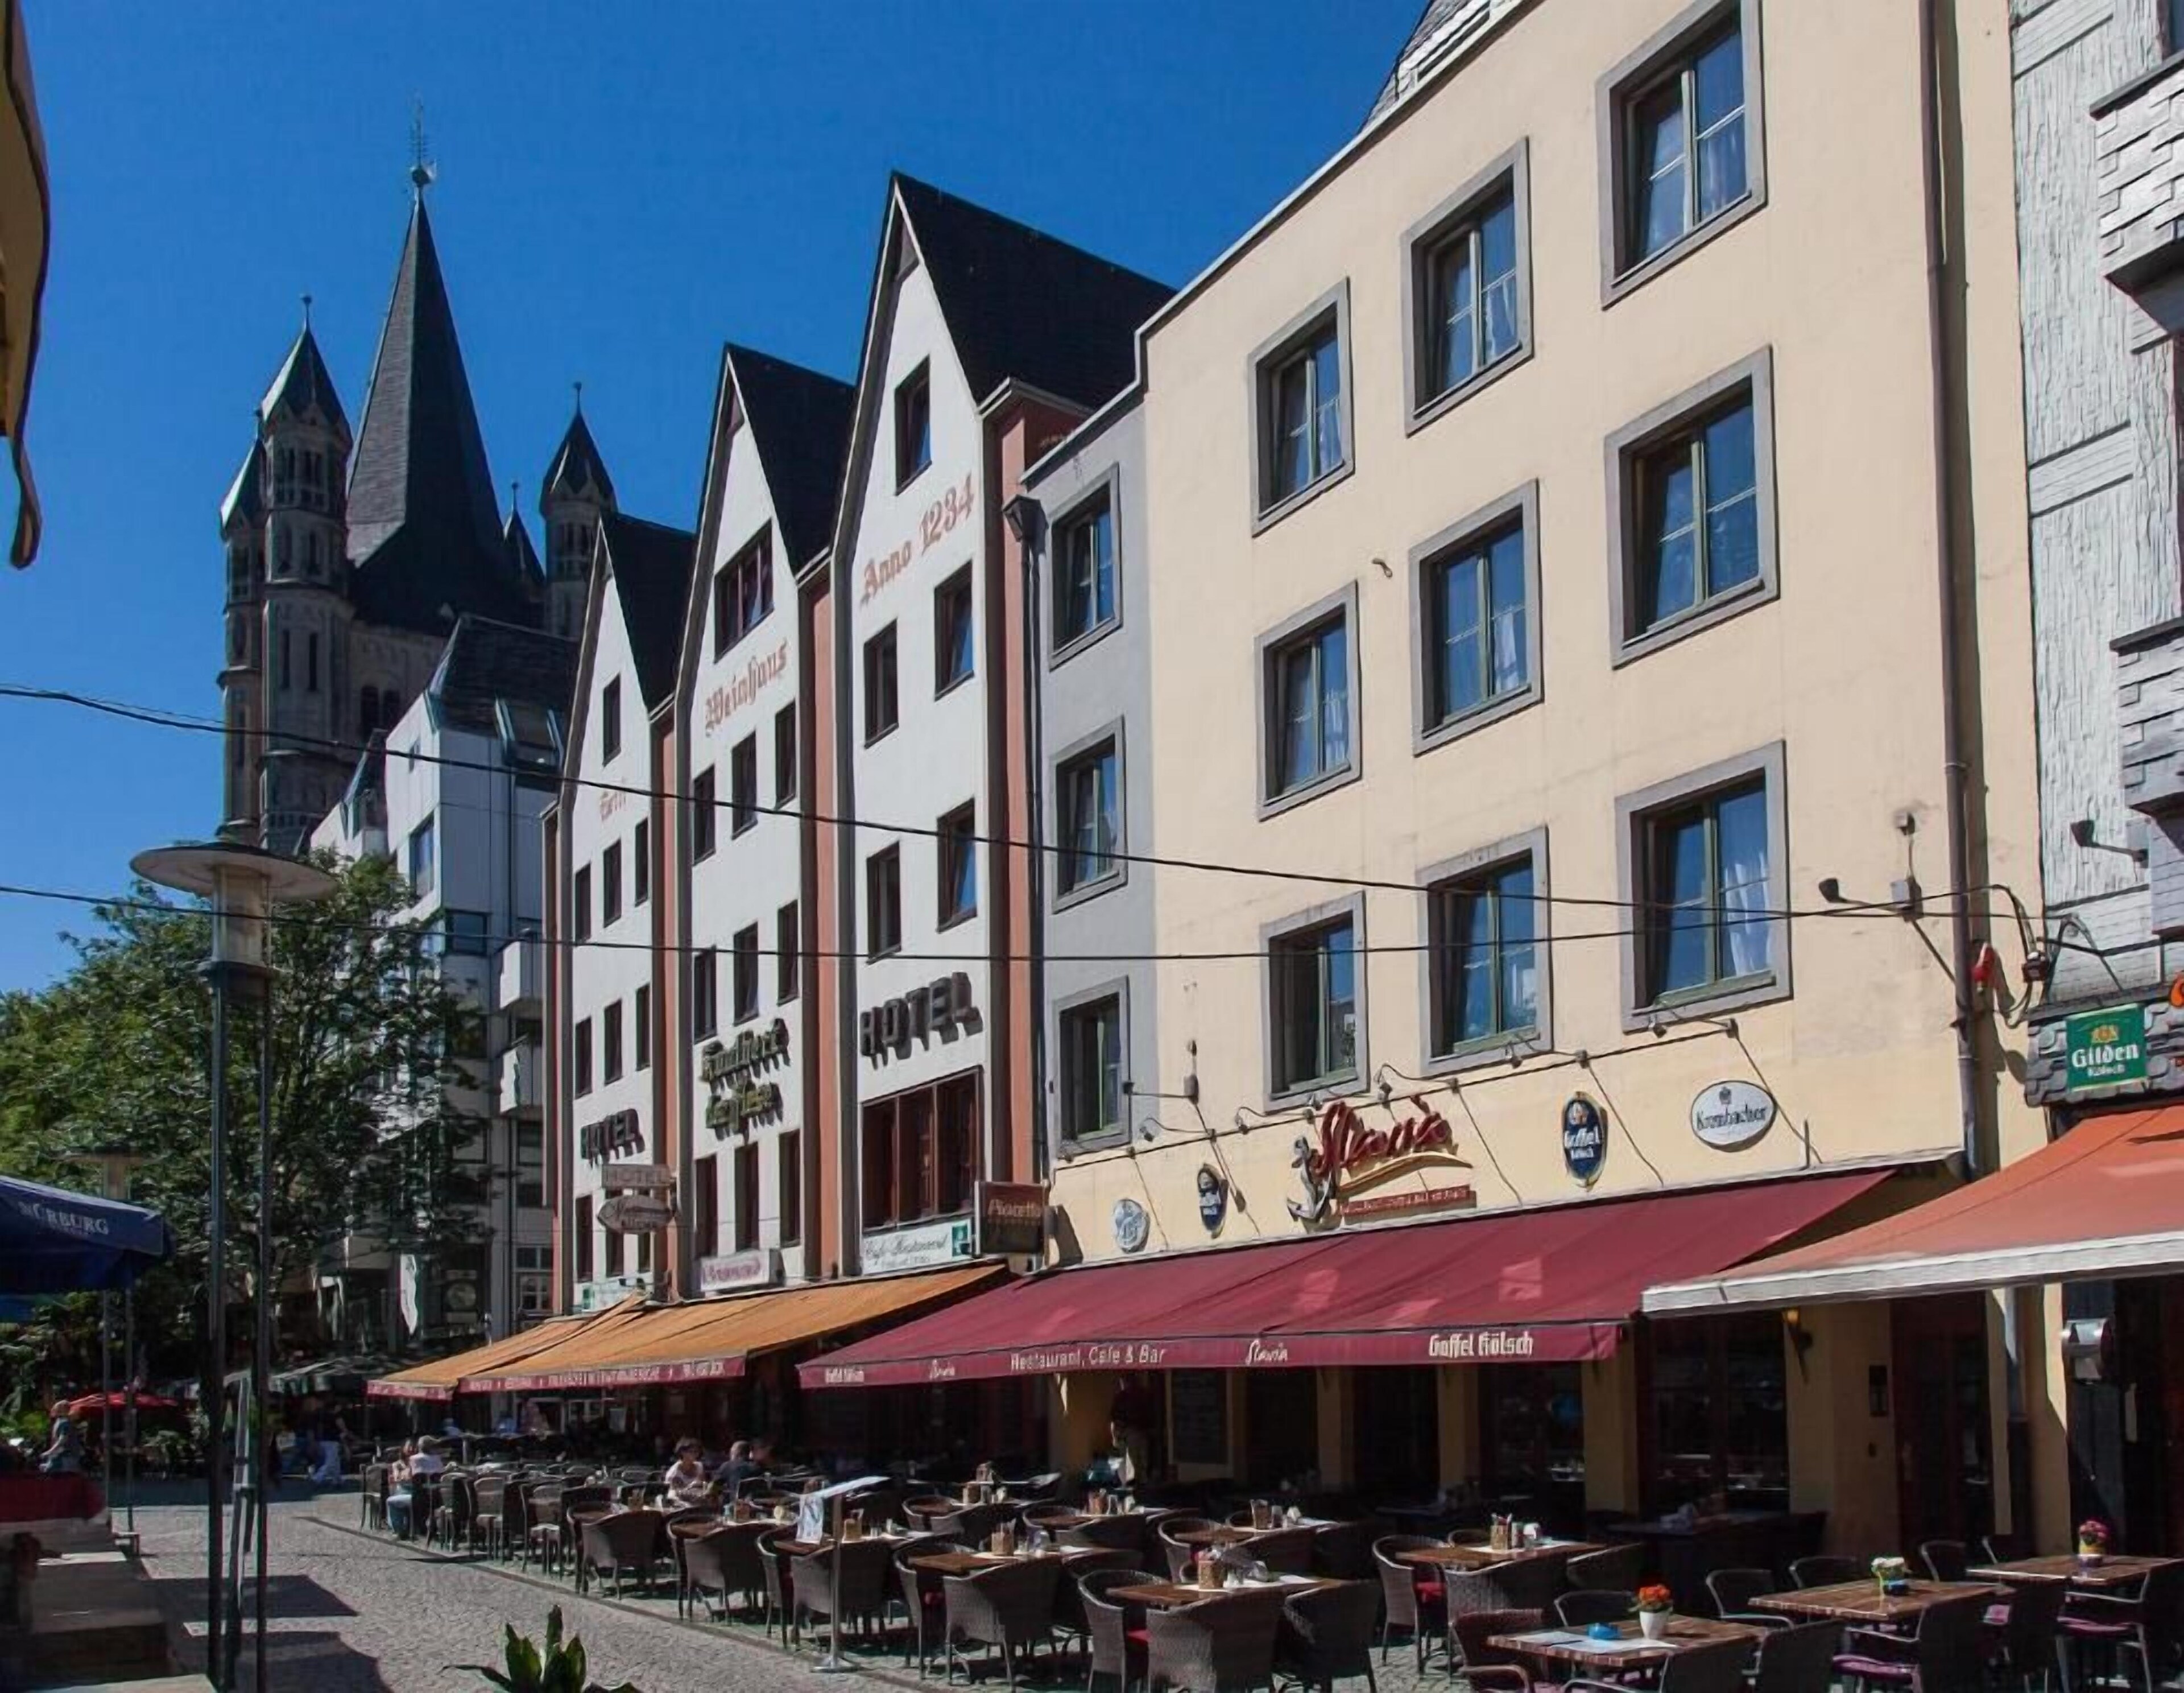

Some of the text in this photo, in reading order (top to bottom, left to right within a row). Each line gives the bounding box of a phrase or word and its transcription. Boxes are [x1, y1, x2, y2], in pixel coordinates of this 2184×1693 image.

[860, 971, 983, 1068] HOTEL
[2071, 1043, 2140, 1068] Gilden
[1139, 1344, 1167, 1364] Bar
[1429, 1333, 1474, 1358] Gaffel
